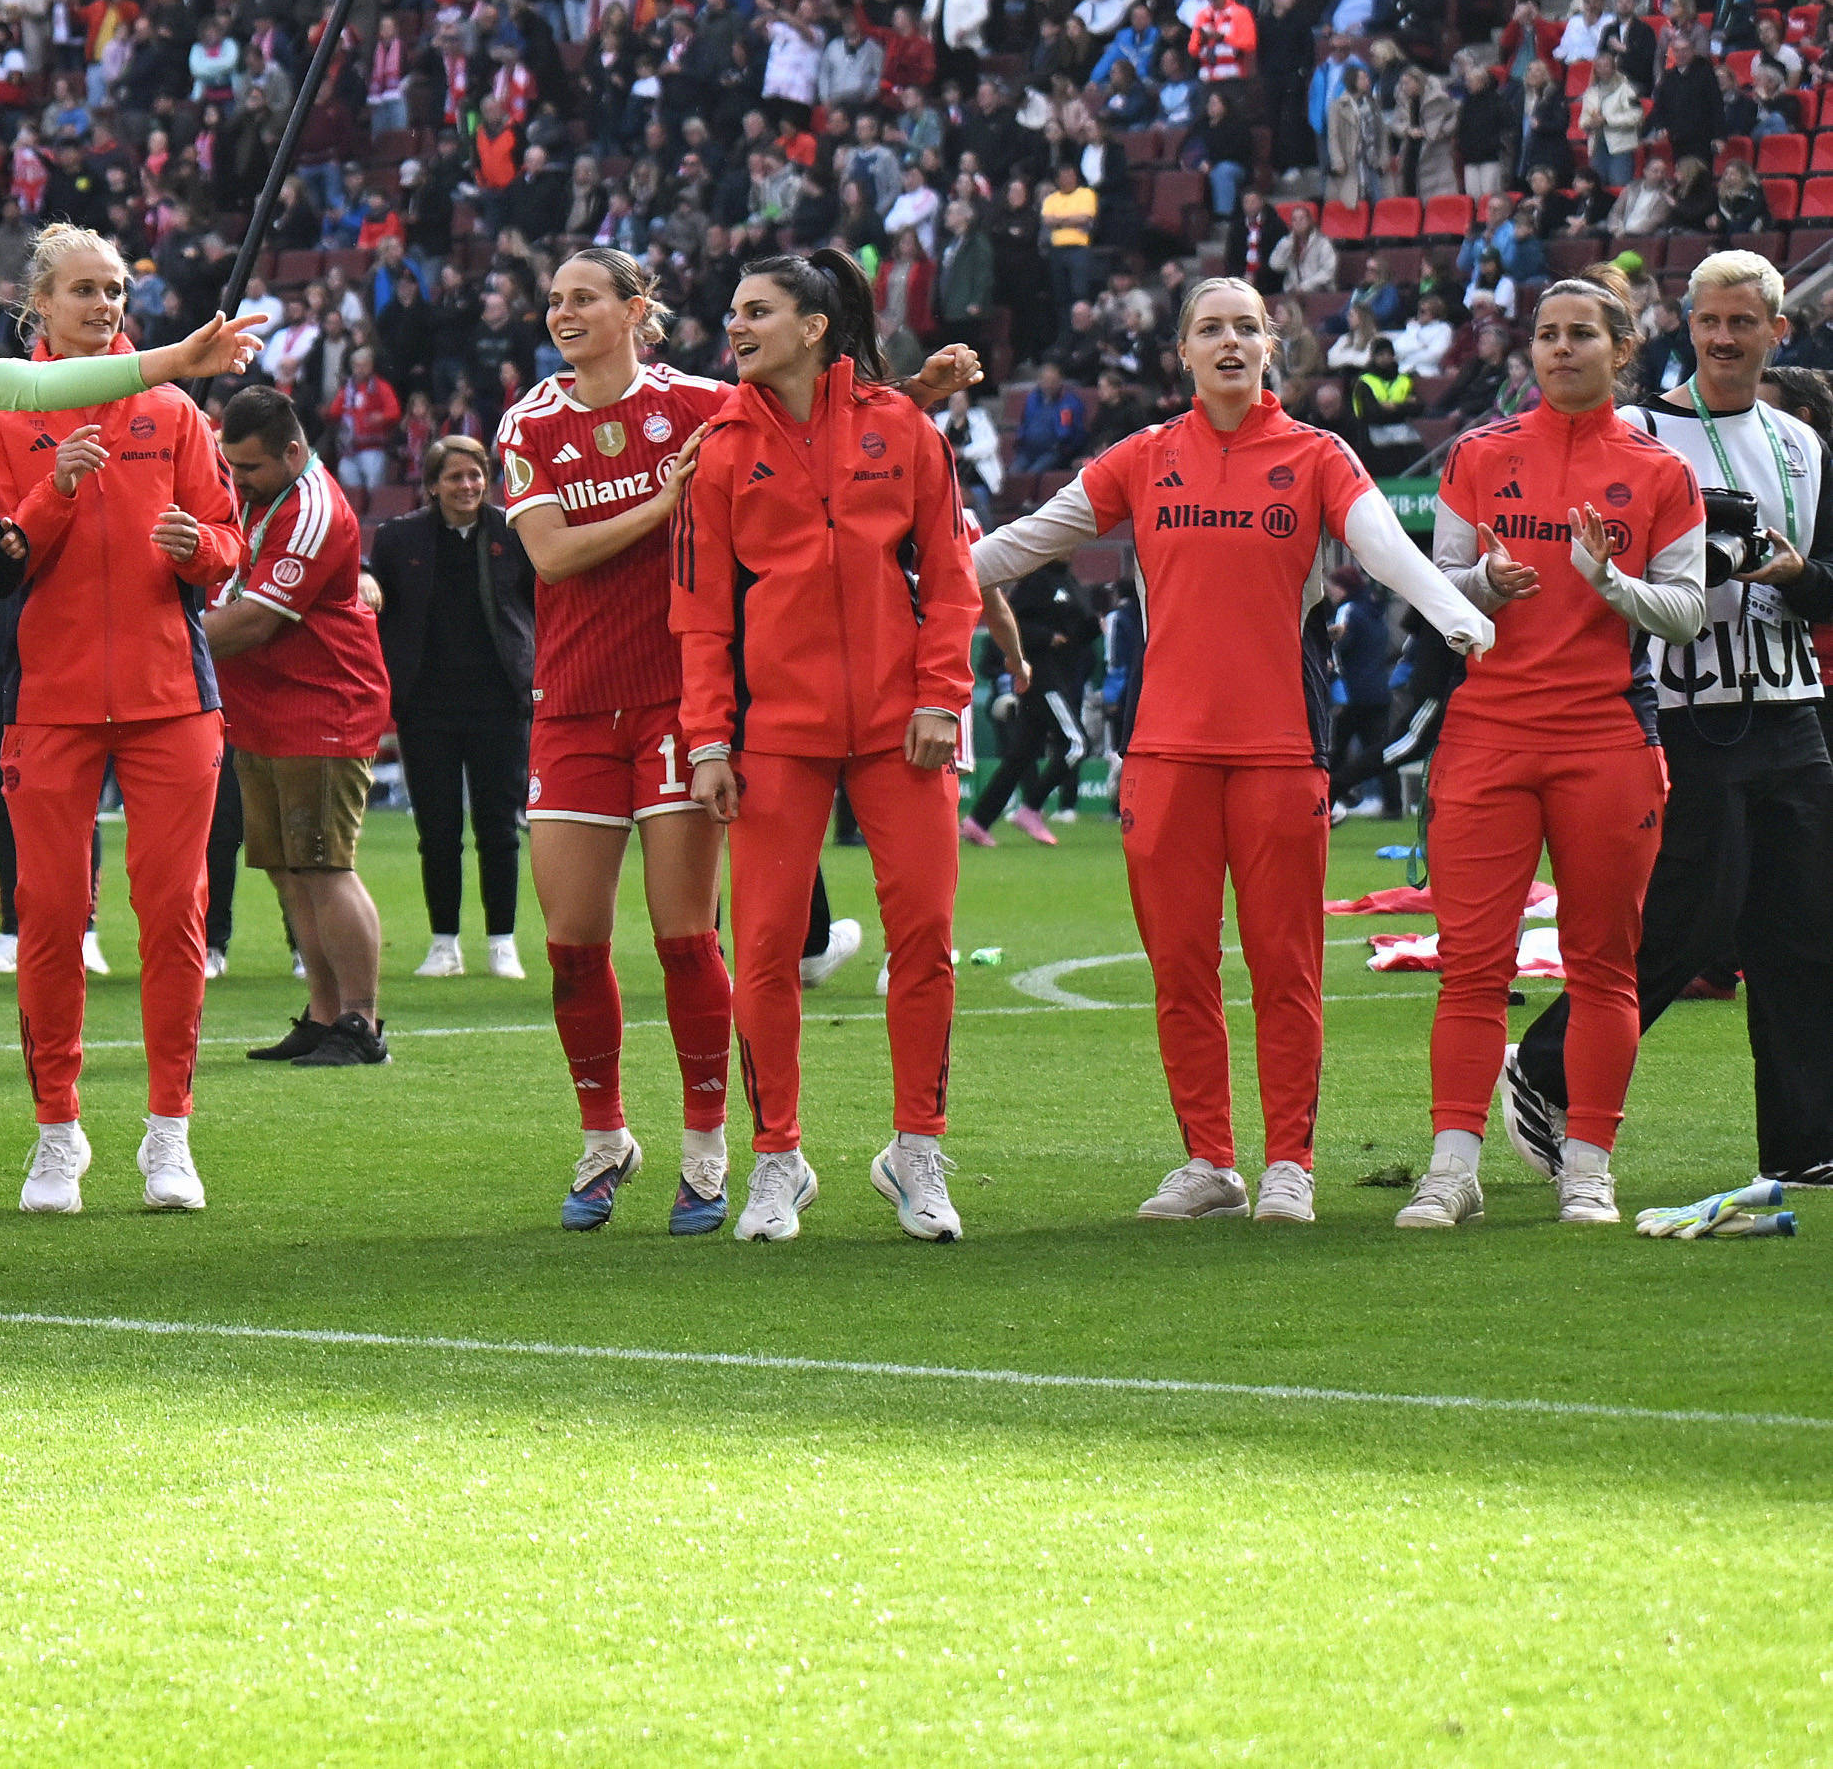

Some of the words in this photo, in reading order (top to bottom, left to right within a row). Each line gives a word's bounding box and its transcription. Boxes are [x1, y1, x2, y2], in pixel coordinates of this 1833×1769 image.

[120, 450, 157, 462] Allianz
[852, 471, 890, 483] Allianz
[1155, 504, 1254, 534] Allianz
[1491, 514, 1574, 544] Allian
[258, 581, 294, 603] Allianz
